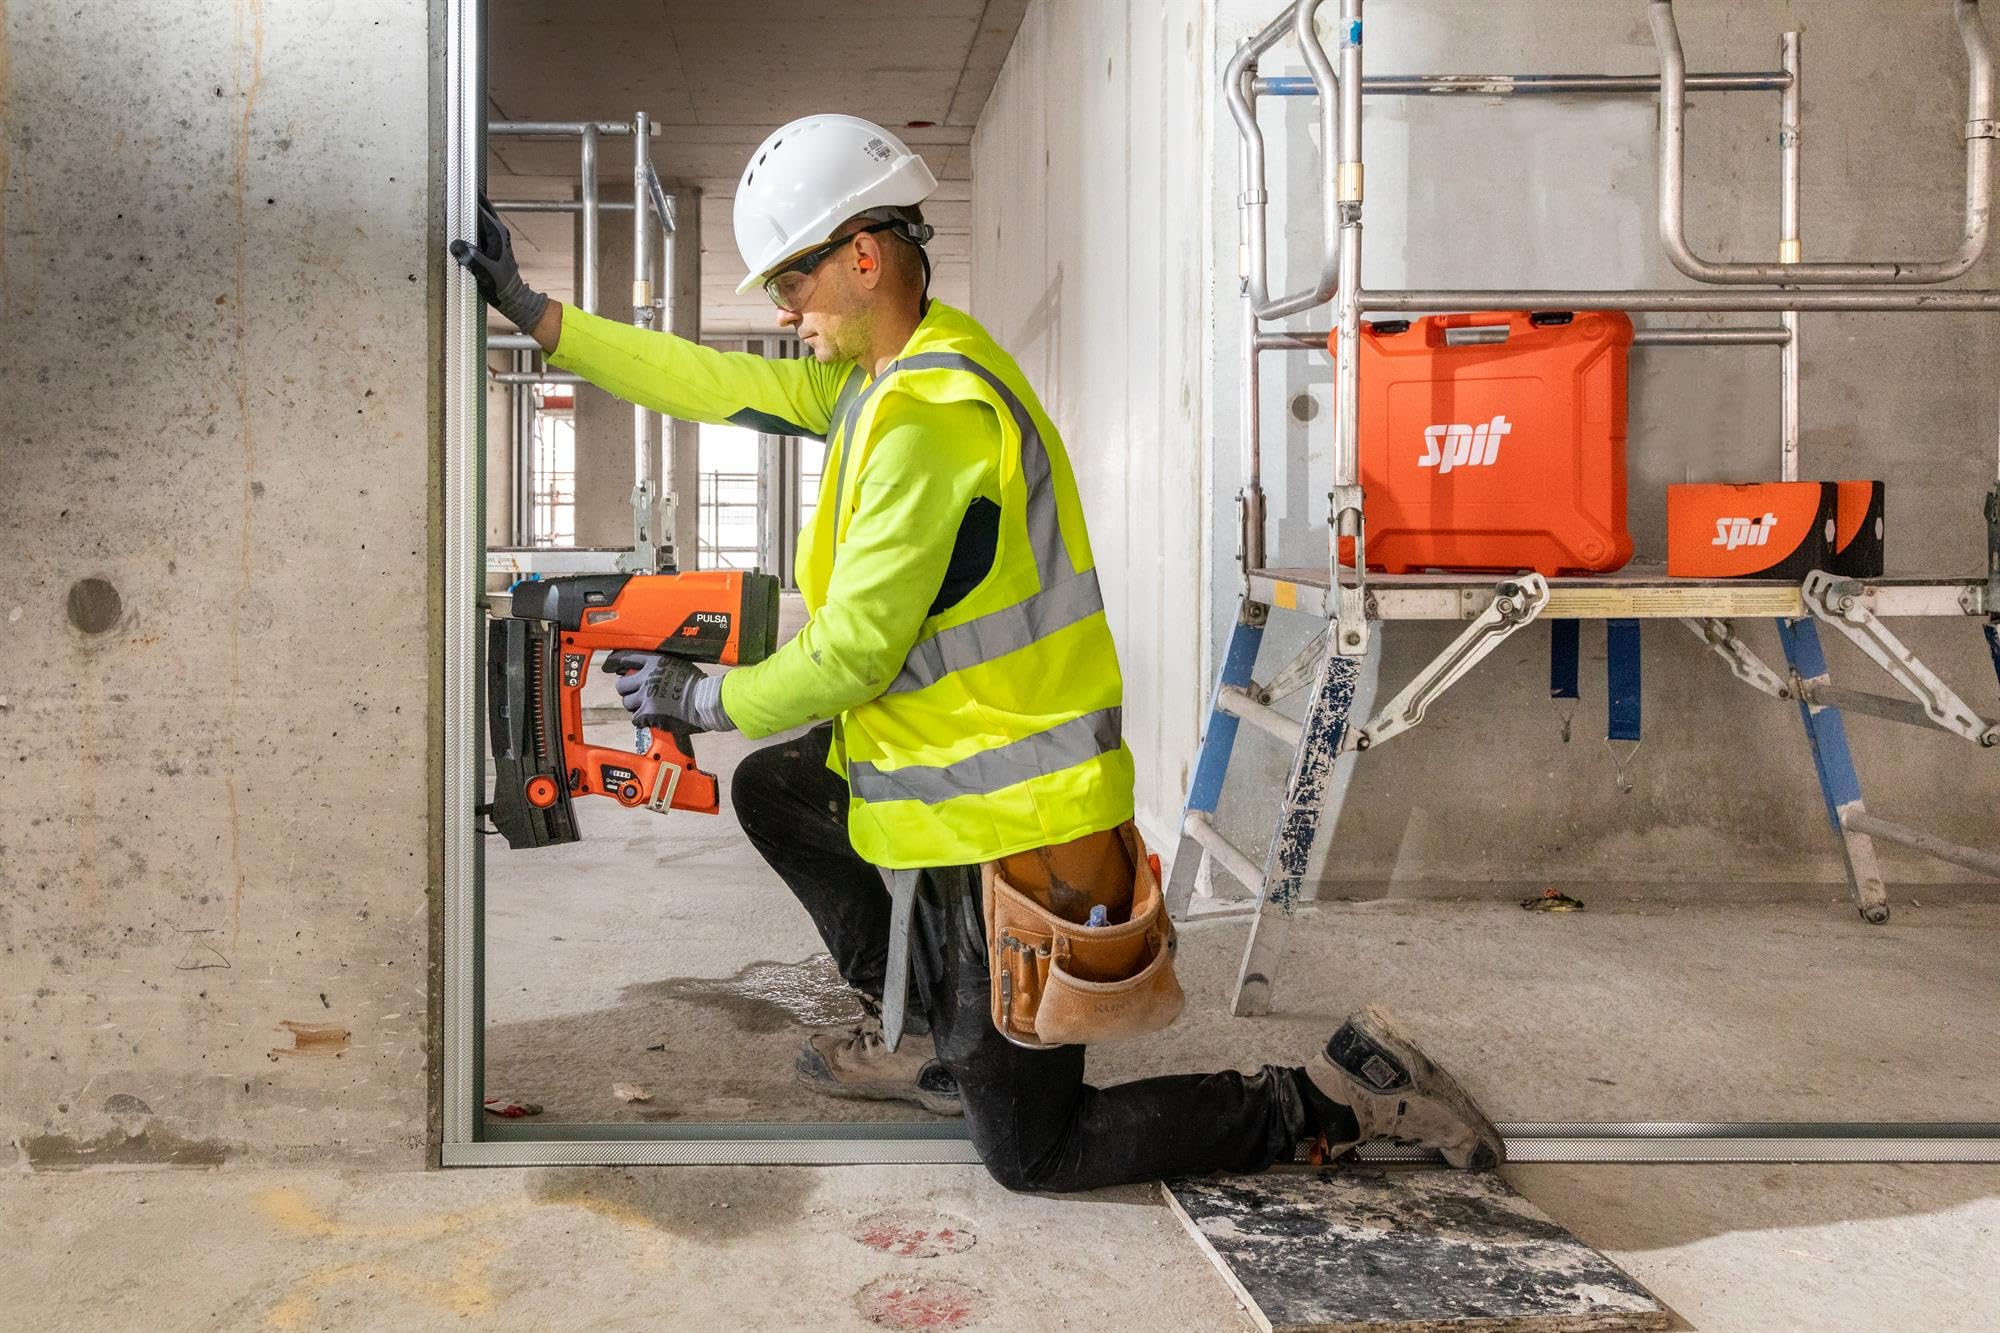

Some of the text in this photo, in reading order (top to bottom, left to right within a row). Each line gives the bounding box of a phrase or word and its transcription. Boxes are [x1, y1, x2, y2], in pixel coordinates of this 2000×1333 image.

[1417, 415, 1512, 474] spit
[1711, 512, 1778, 550] spit
[696, 613, 728, 624] PULSA
[681, 626, 700, 637] spit
